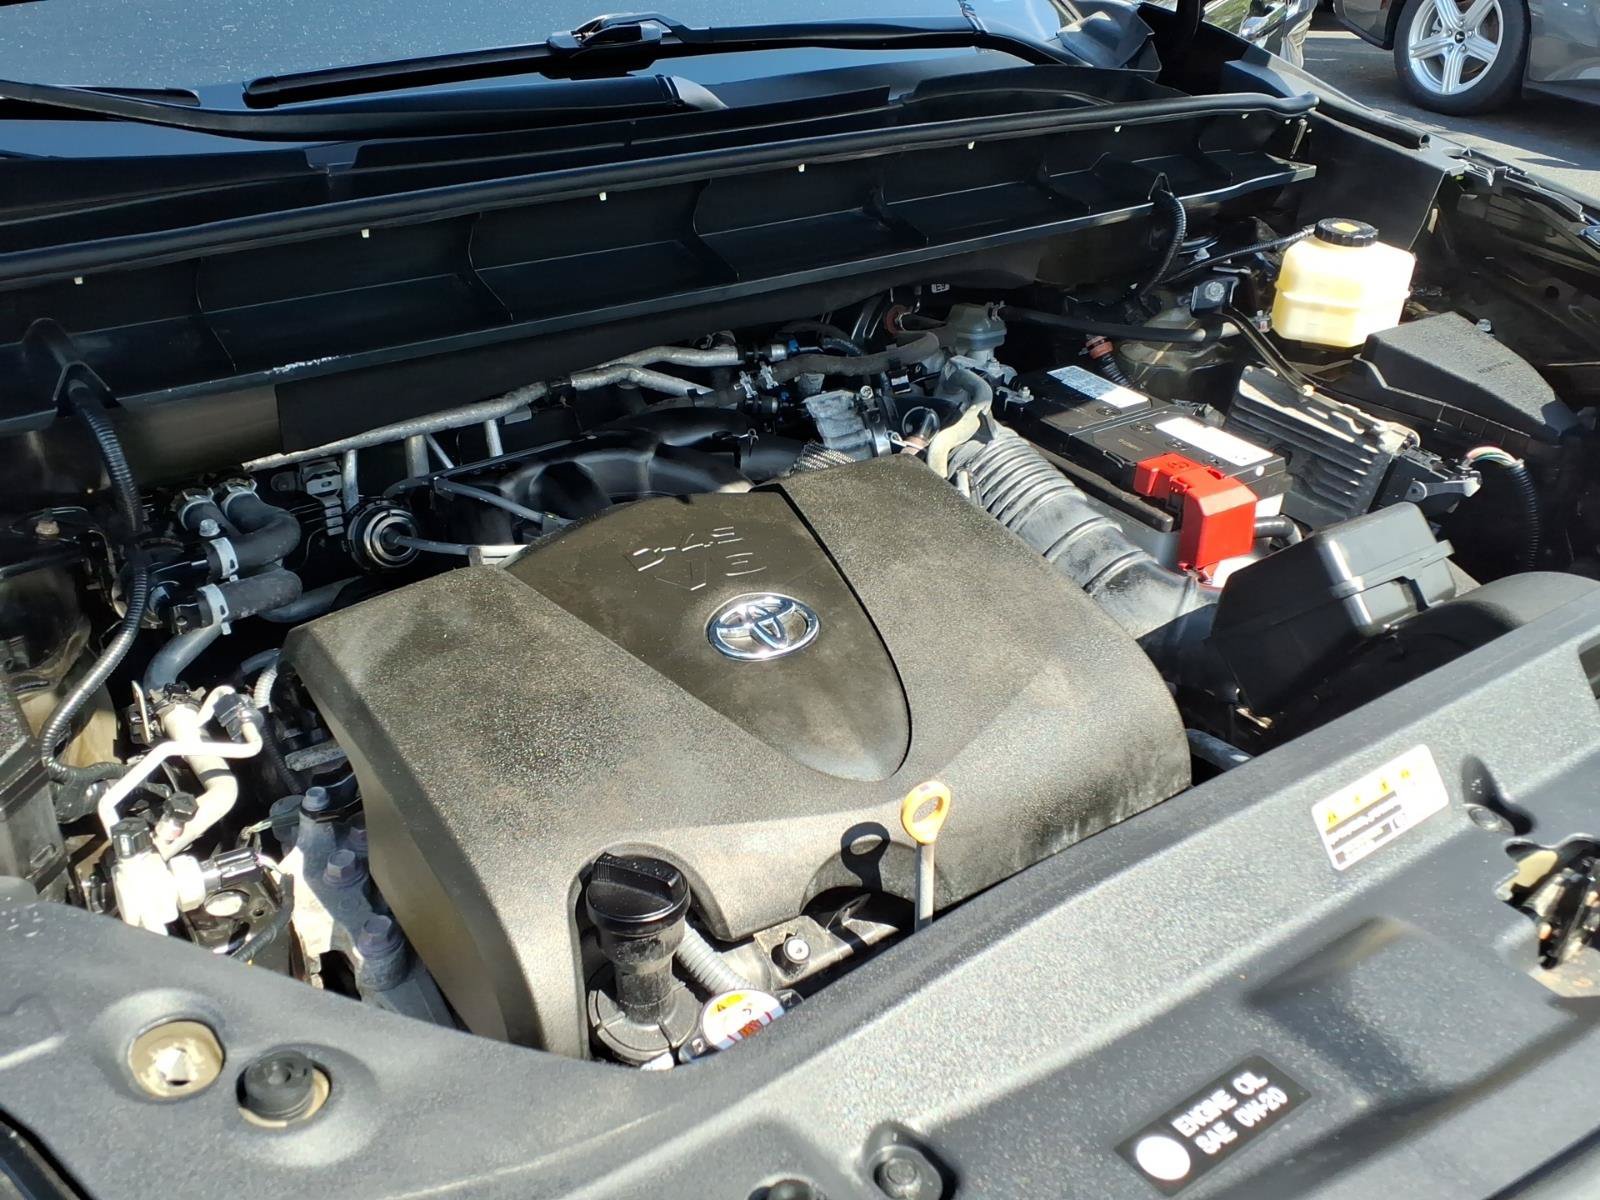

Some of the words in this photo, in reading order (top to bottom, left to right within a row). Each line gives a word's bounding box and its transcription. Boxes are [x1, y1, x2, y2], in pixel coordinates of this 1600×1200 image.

[1171, 1089, 1238, 1138] ENGINE
[1232, 1071, 1268, 1095] OIL
[1194, 1121, 1238, 1155] SAE
[1233, 1086, 1288, 1127] 0W-20
